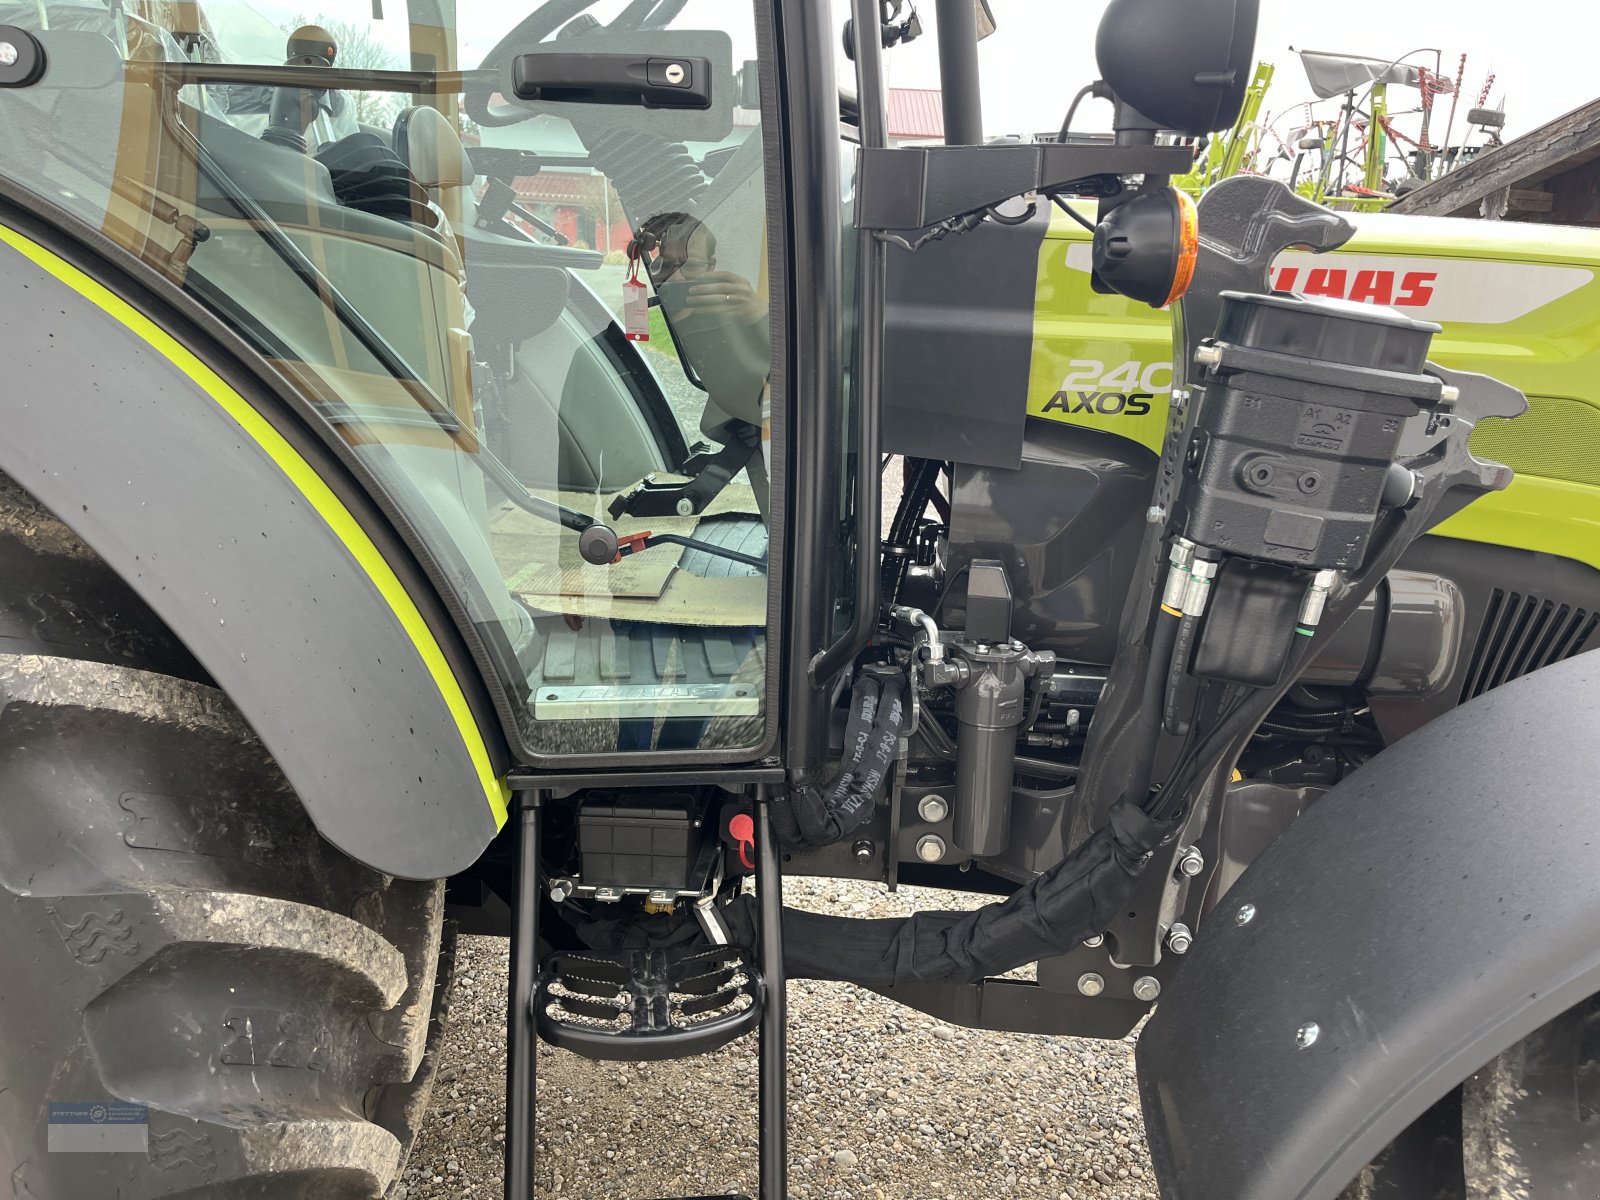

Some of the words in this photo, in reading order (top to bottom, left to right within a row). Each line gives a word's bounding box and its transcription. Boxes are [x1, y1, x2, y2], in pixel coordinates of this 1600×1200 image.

[1061, 359, 1173, 393] 240
[1041, 390, 1154, 416] AXOS
[1303, 407, 1322, 419] A1
